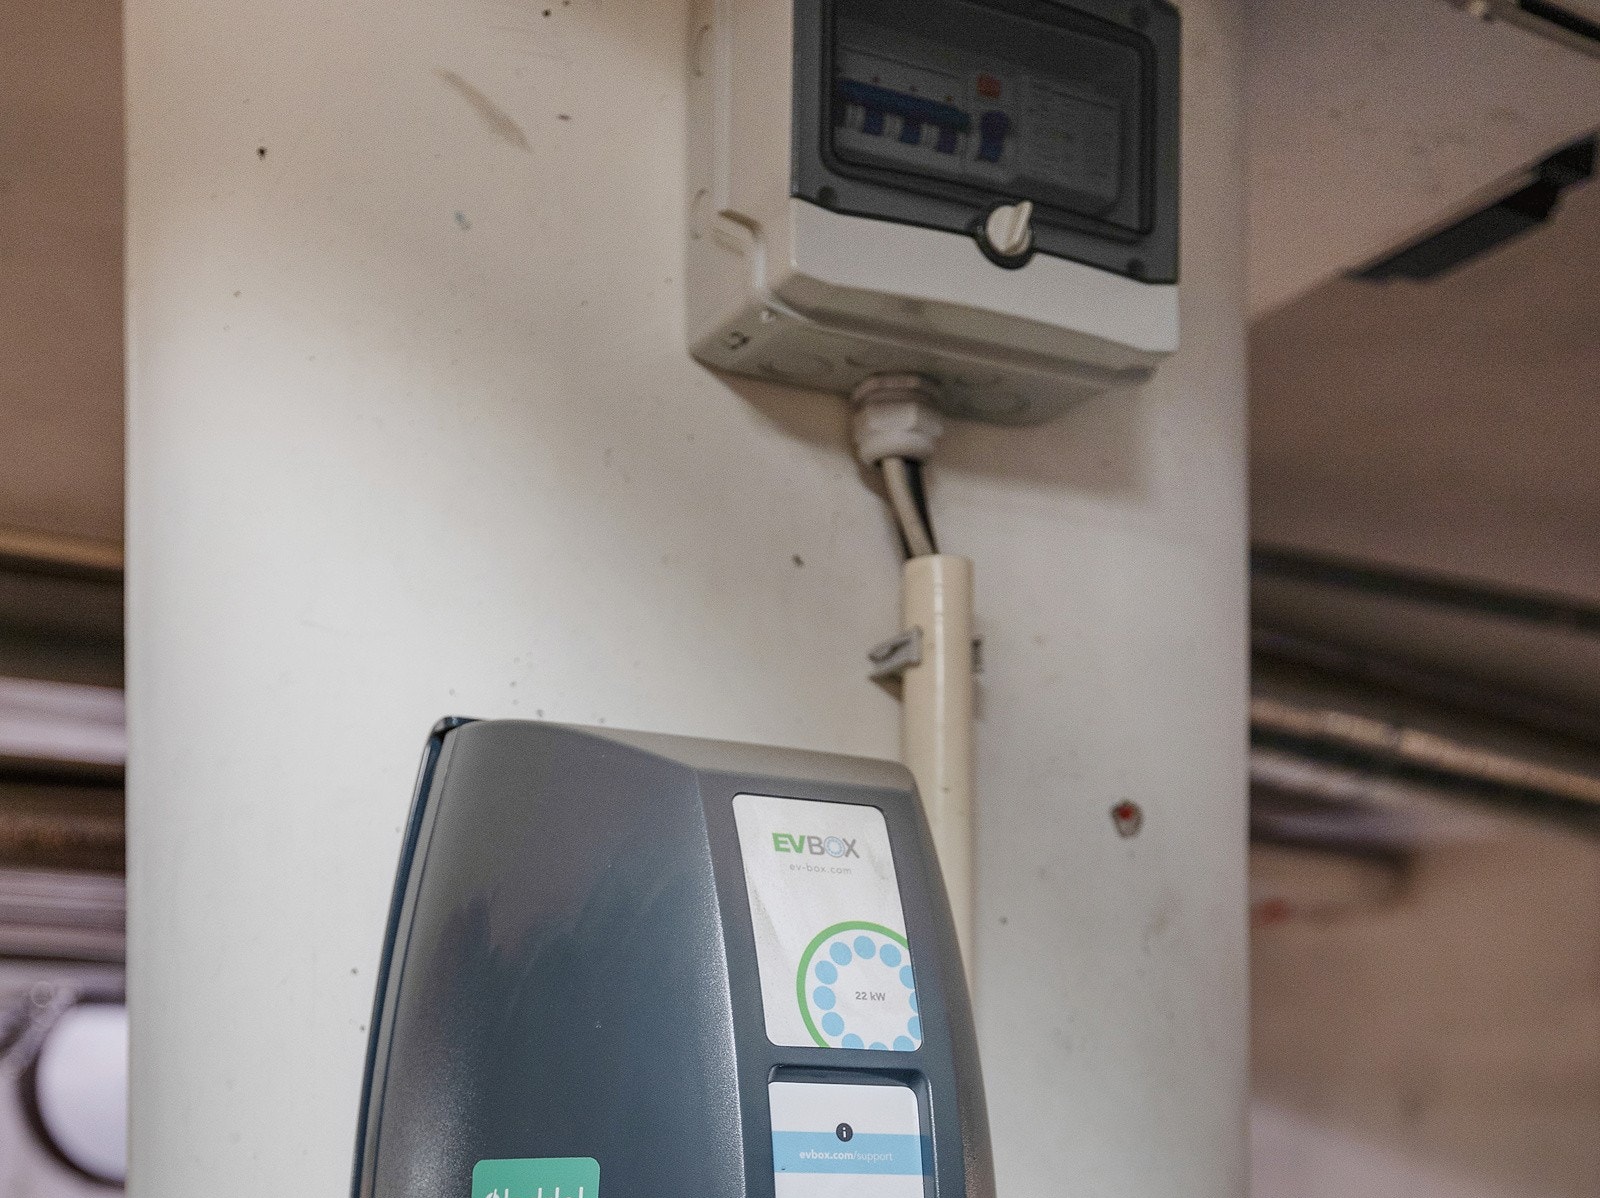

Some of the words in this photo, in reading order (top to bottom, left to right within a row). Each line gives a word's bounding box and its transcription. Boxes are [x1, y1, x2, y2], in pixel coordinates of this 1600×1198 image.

[772, 832, 860, 859] EVBOX
[789, 863, 852, 875] ev-box.com
[855, 991, 867, 1000] 22
[870, 991, 886, 1001] kW
[799, 1149, 894, 1163] evbox.com/support
